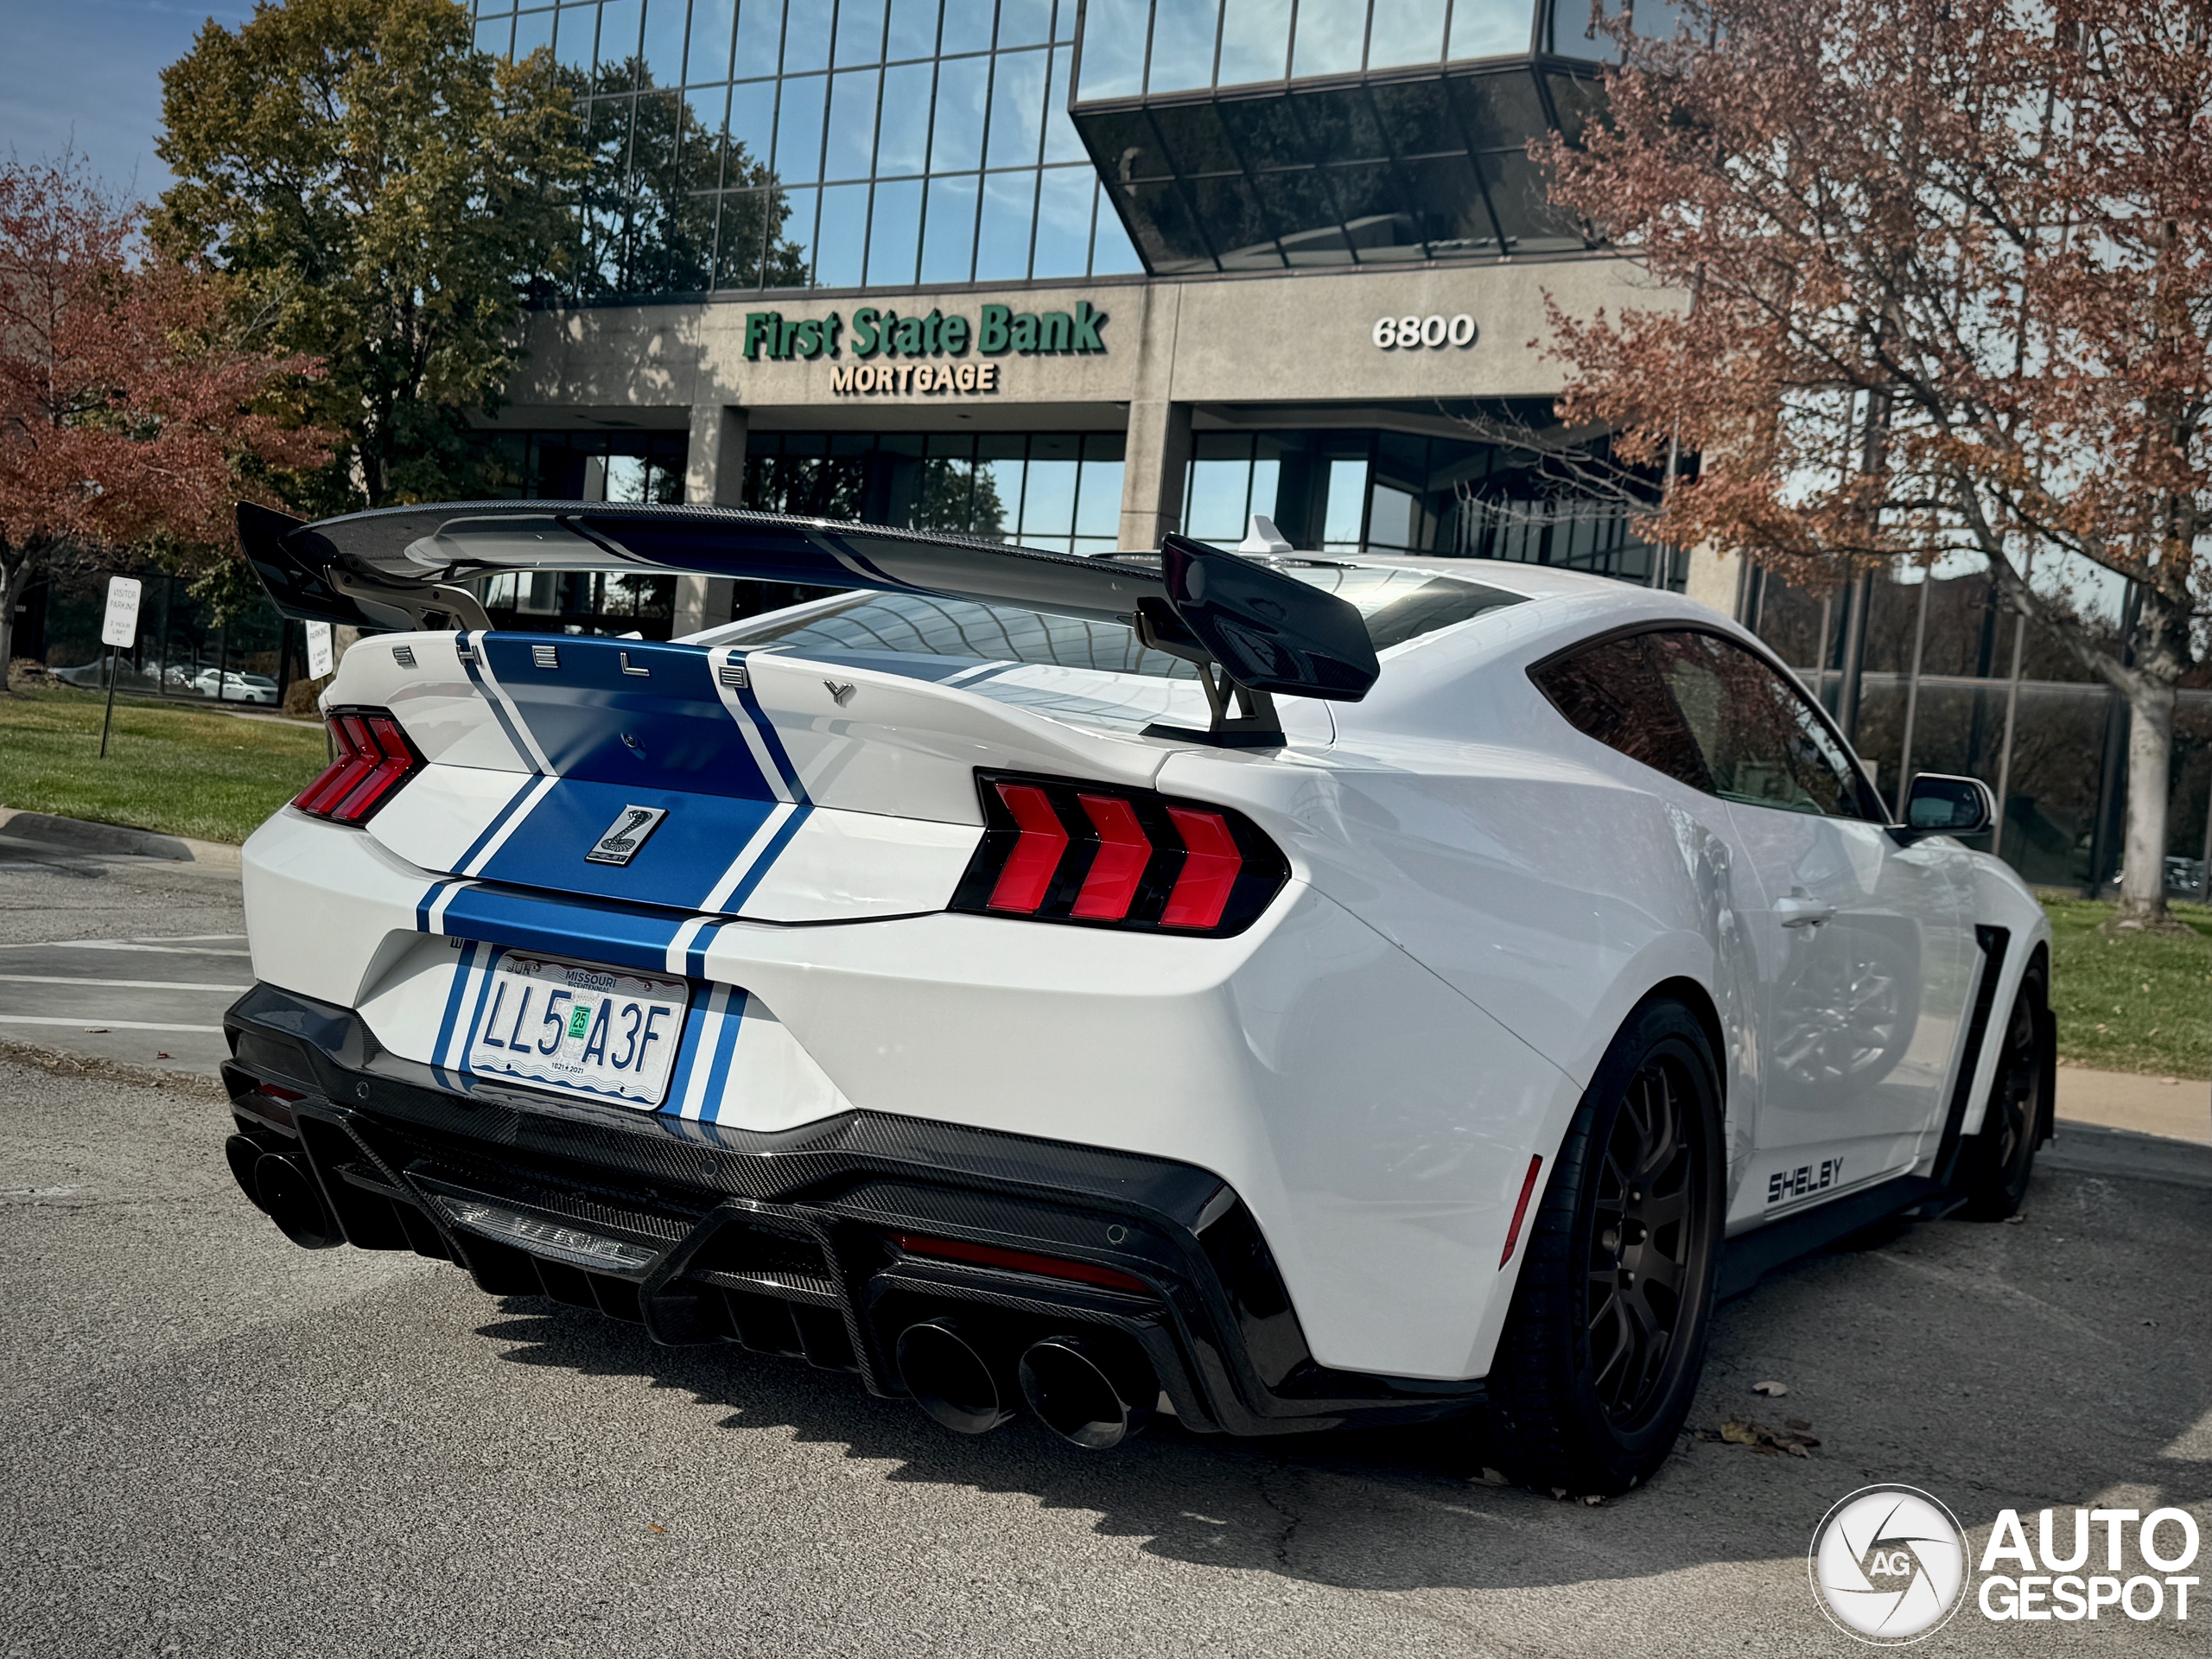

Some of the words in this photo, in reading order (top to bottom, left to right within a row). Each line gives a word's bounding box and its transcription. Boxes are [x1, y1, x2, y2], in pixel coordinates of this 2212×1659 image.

[742, 311, 840, 359] First
[851, 307, 969, 358] State
[977, 301, 1106, 355] Bank
[1372, 314, 1476, 348] 6800
[830, 364, 996, 393] MORTGAGE
[113, 588, 137, 599] VISITOR
[110, 600, 136, 612] PARKING
[392, 644, 855, 708] SHELBY
[566, 970, 617, 988] MISSOURI
[568, 981, 610, 994] BICENTENNIAL
[482, 981, 572, 1057] LL5
[581, 998, 671, 1073] A3F
[573, 1012, 586, 1028] 25
[569, 1065, 583, 1074] 2021
[1768, 1156, 1844, 1204] SHELBY
